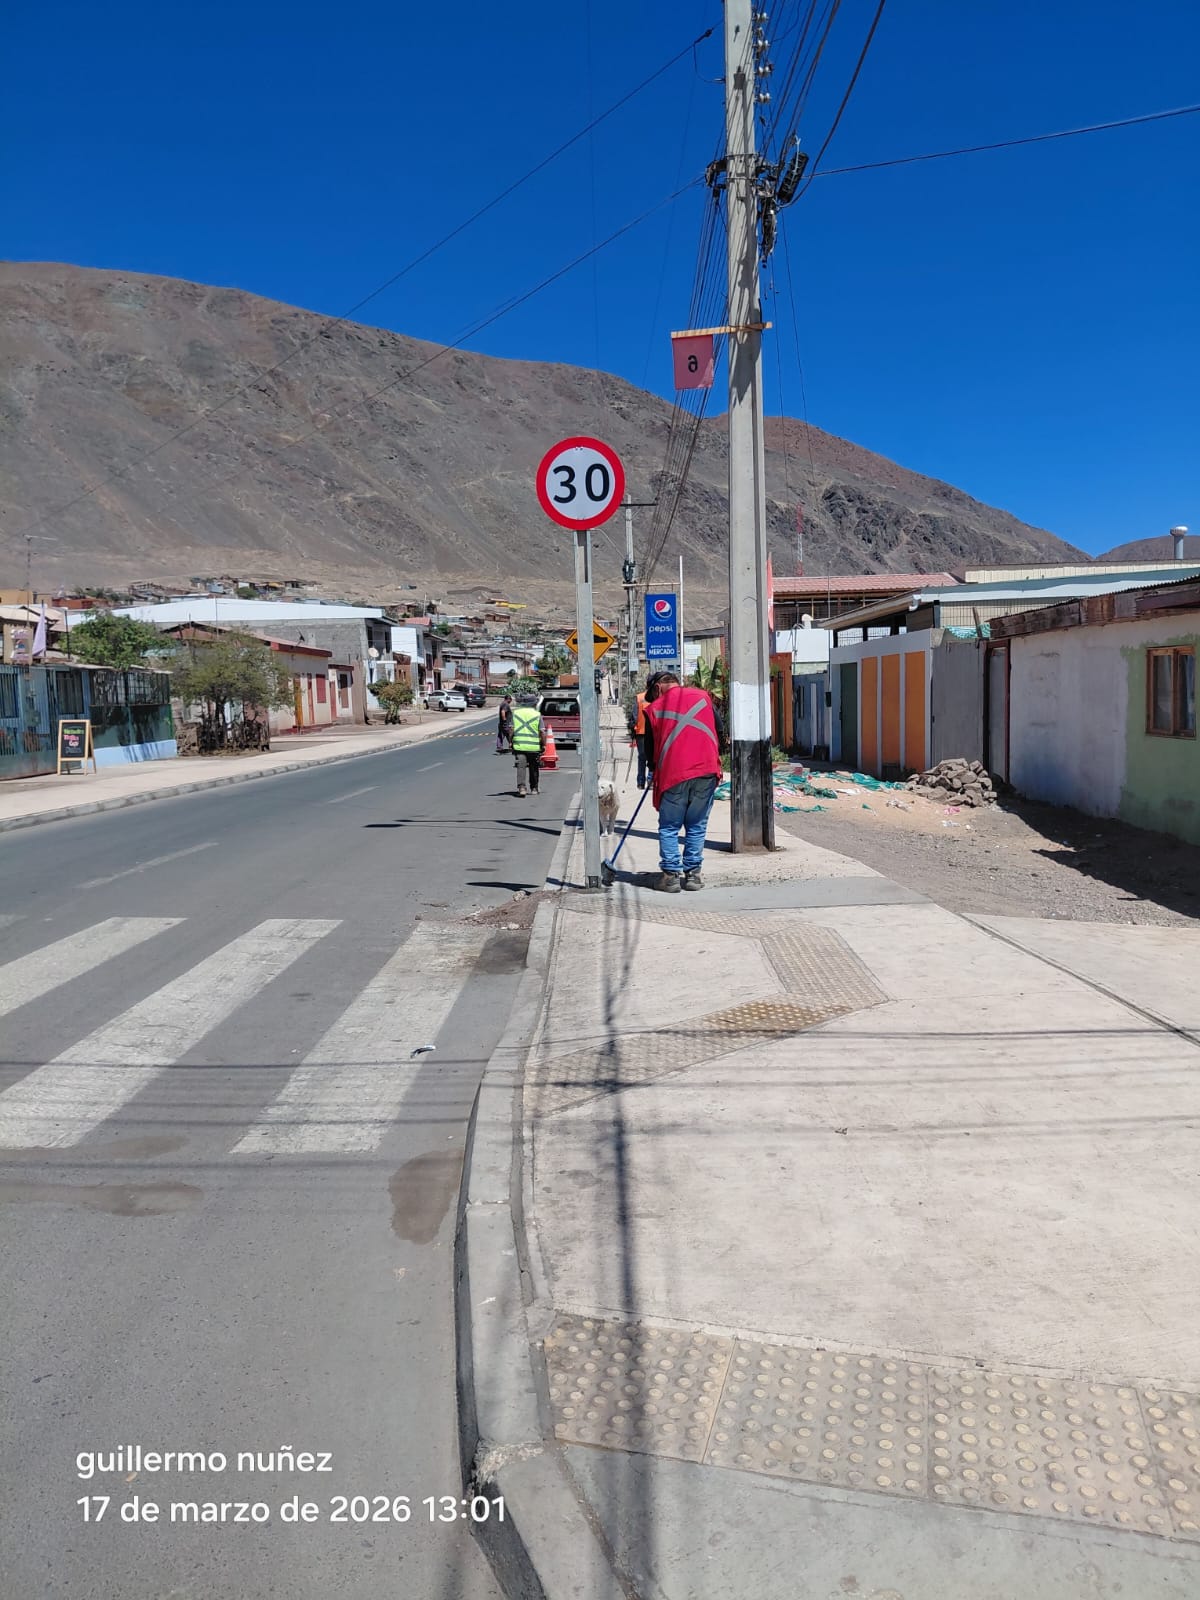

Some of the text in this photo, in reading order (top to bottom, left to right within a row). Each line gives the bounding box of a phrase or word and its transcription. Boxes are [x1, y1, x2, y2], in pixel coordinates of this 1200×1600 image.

[552, 463, 610, 504] 30
[648, 625, 674, 634] pepsi
[648, 648, 675, 656] MERCADO
